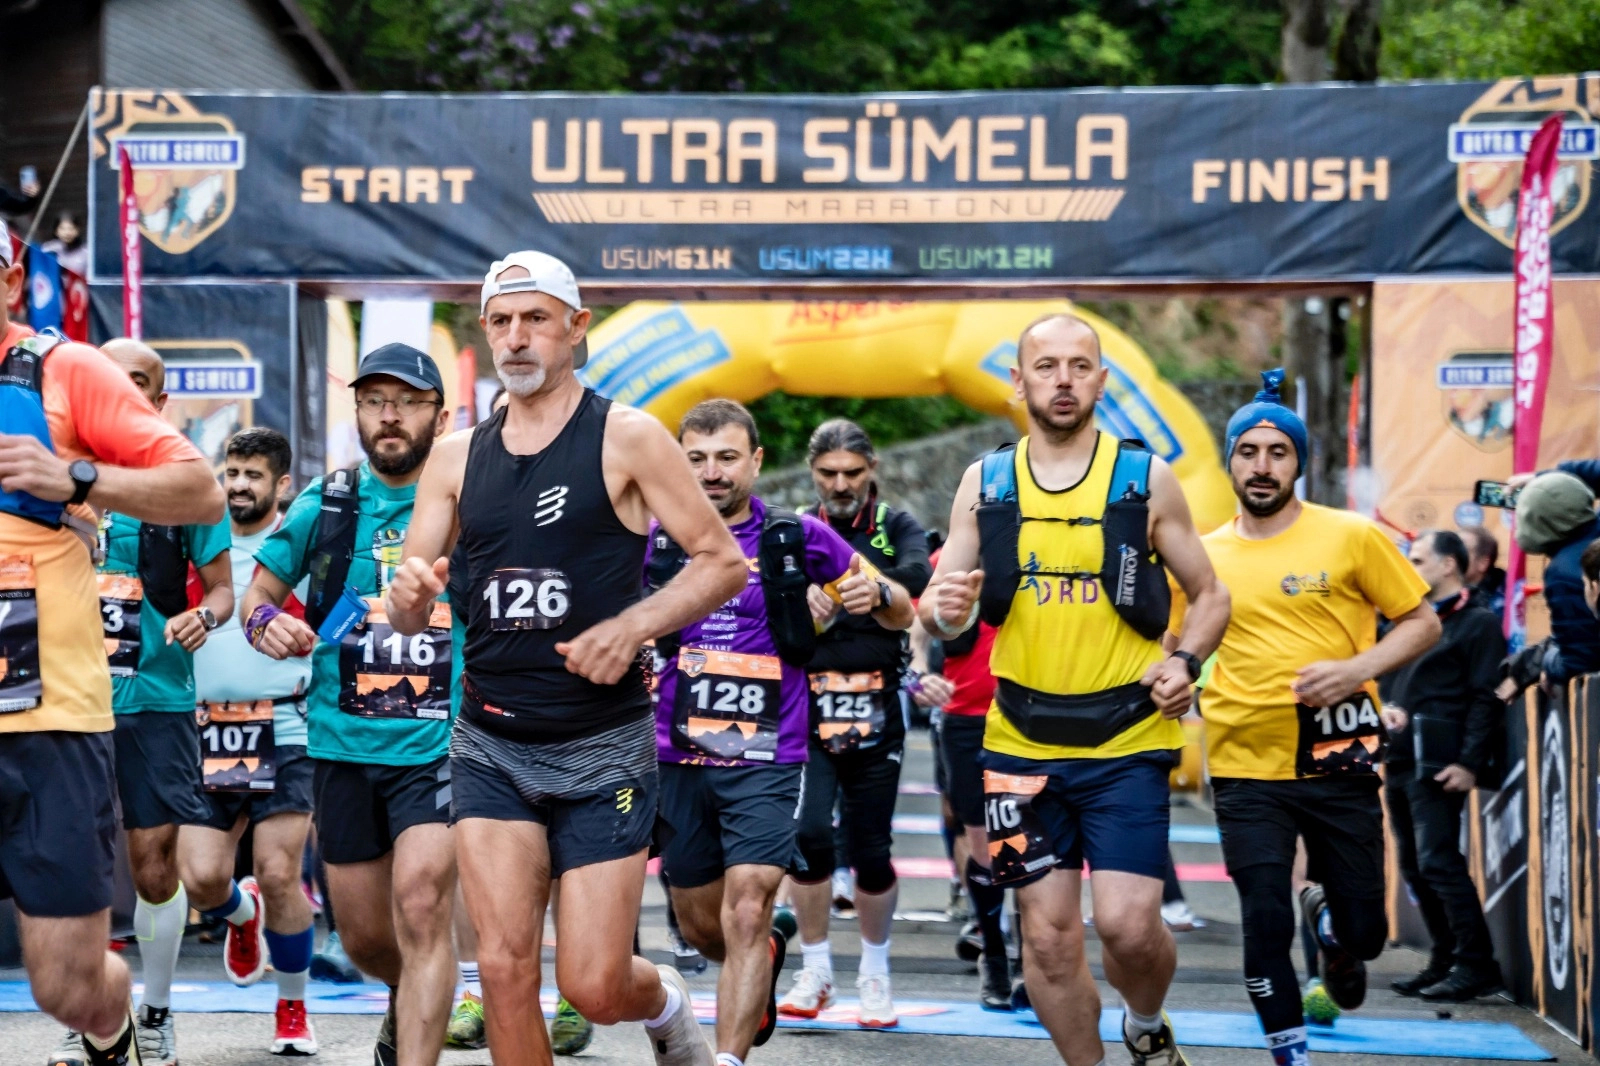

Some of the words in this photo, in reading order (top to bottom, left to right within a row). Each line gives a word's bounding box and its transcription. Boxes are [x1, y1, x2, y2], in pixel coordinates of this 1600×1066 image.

[531, 118, 778, 185] ULTRA
[802, 101, 1129, 184] SÜMELA
[301, 167, 474, 203] START
[1192, 157, 1390, 203] FINISH
[606, 198, 752, 219] ULTRA
[785, 196, 1048, 218] MARATONU
[483, 579, 569, 619] 126
[357, 631, 436, 667] 116
[690, 679, 766, 714] 128
[816, 693, 874, 718] 125
[1314, 698, 1379, 735] 104
[203, 725, 263, 752] 107
